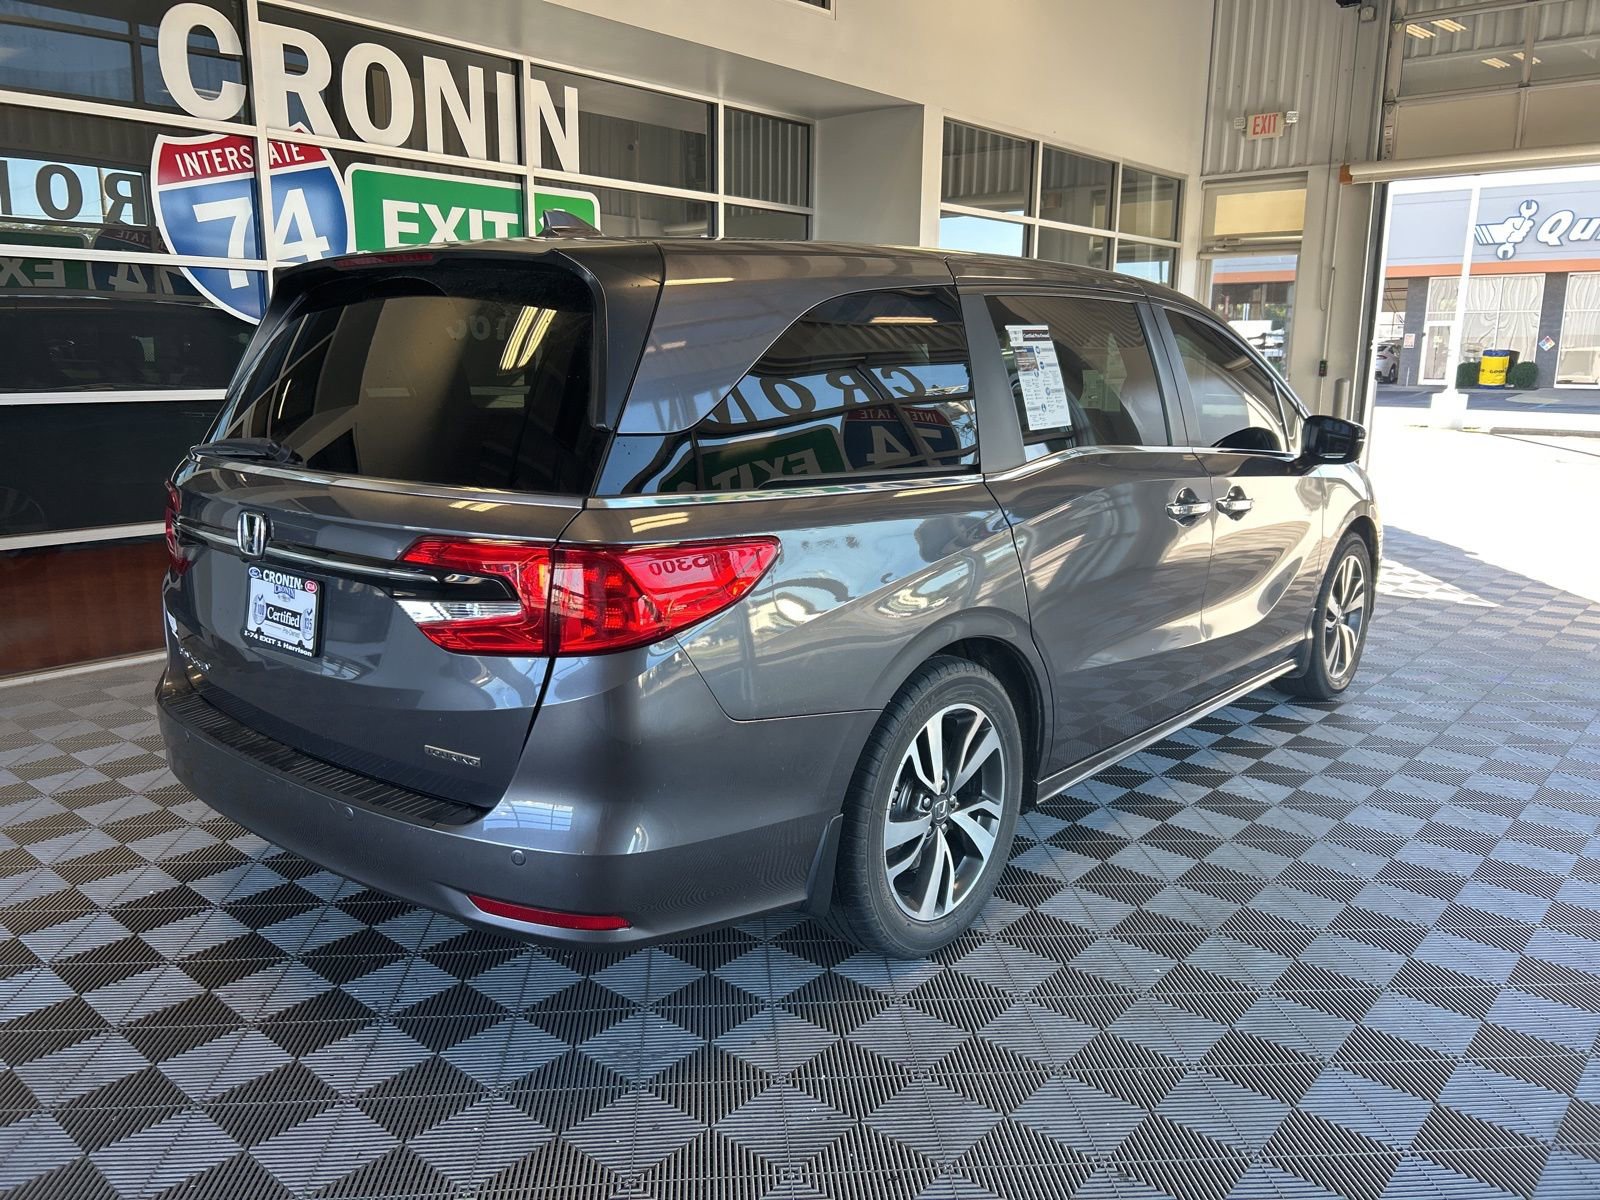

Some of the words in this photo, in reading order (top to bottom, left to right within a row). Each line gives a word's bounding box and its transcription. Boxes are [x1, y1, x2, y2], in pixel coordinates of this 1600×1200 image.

[157, 2, 580, 174] CRONIN
[1252, 113, 1278, 136] EXIT
[175, 142, 305, 178] INTERSATE
[192, 188, 330, 290] 74
[382, 199, 518, 248] EXIT
[1536, 209, 1600, 246] Qu
[263, 569, 302, 590] CRONIN
[274, 584, 295, 599] CRONIN
[267, 606, 300, 628] Certified
[244, 630, 258, 639] I-74
[260, 635, 276, 645] EXIT
[283, 642, 313, 657] Harrison
